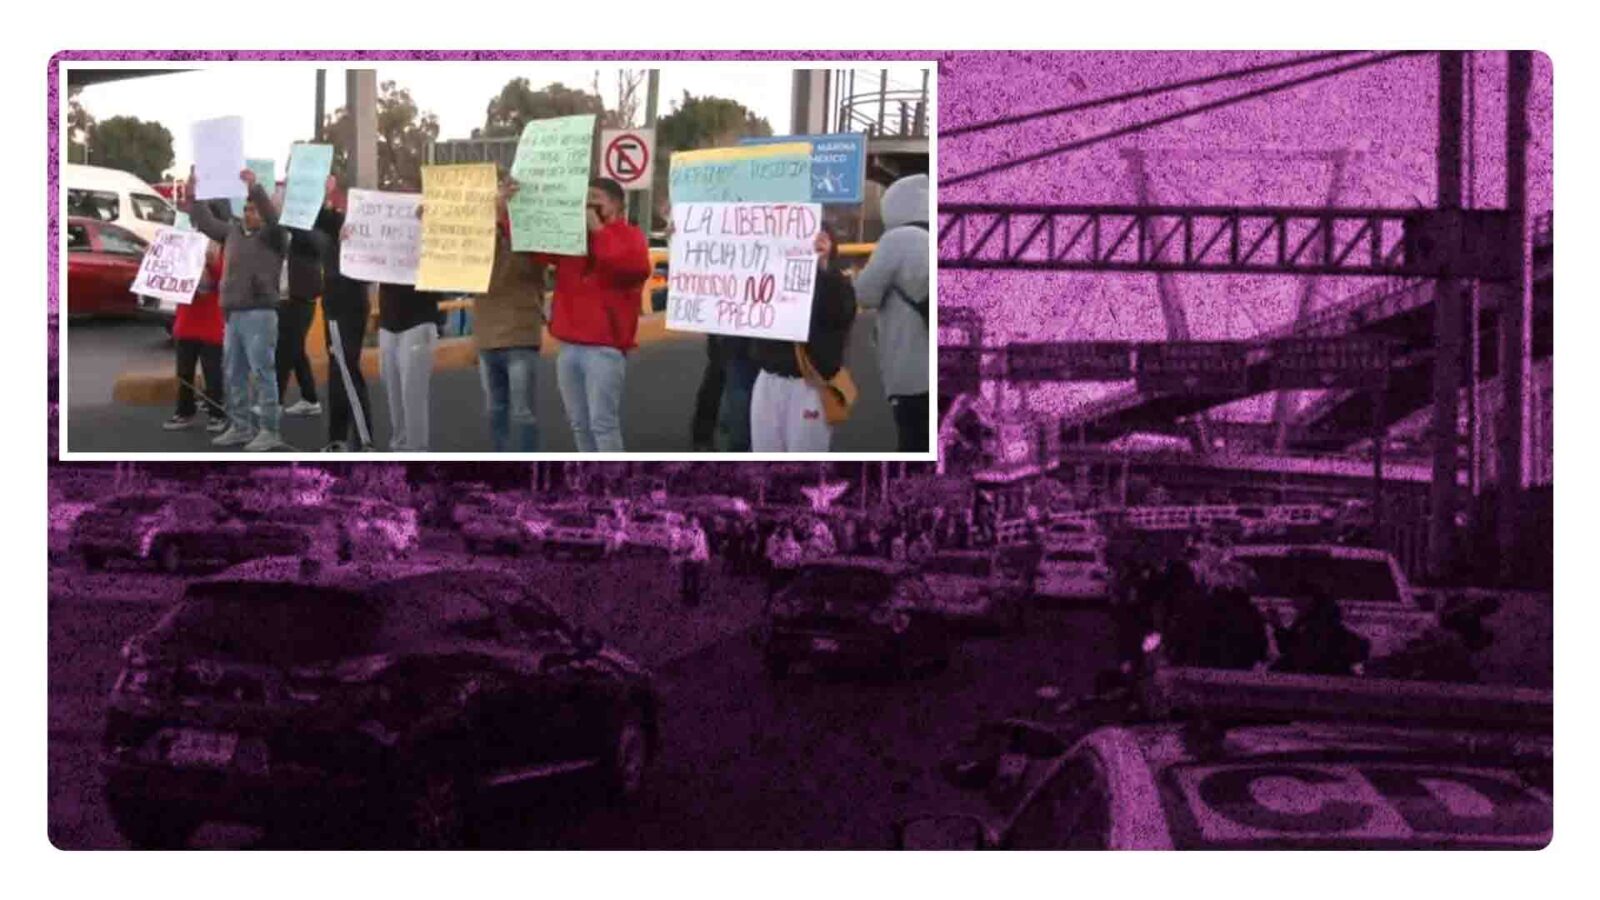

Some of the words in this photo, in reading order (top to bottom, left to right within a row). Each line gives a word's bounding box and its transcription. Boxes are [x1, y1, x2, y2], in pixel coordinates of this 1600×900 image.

[683, 205, 714, 234] LA
[721, 205, 816, 239] LIBERTAD
[685, 241, 736, 272] HACIA
[743, 272, 775, 305] NO
[714, 298, 775, 329] PRECIO
